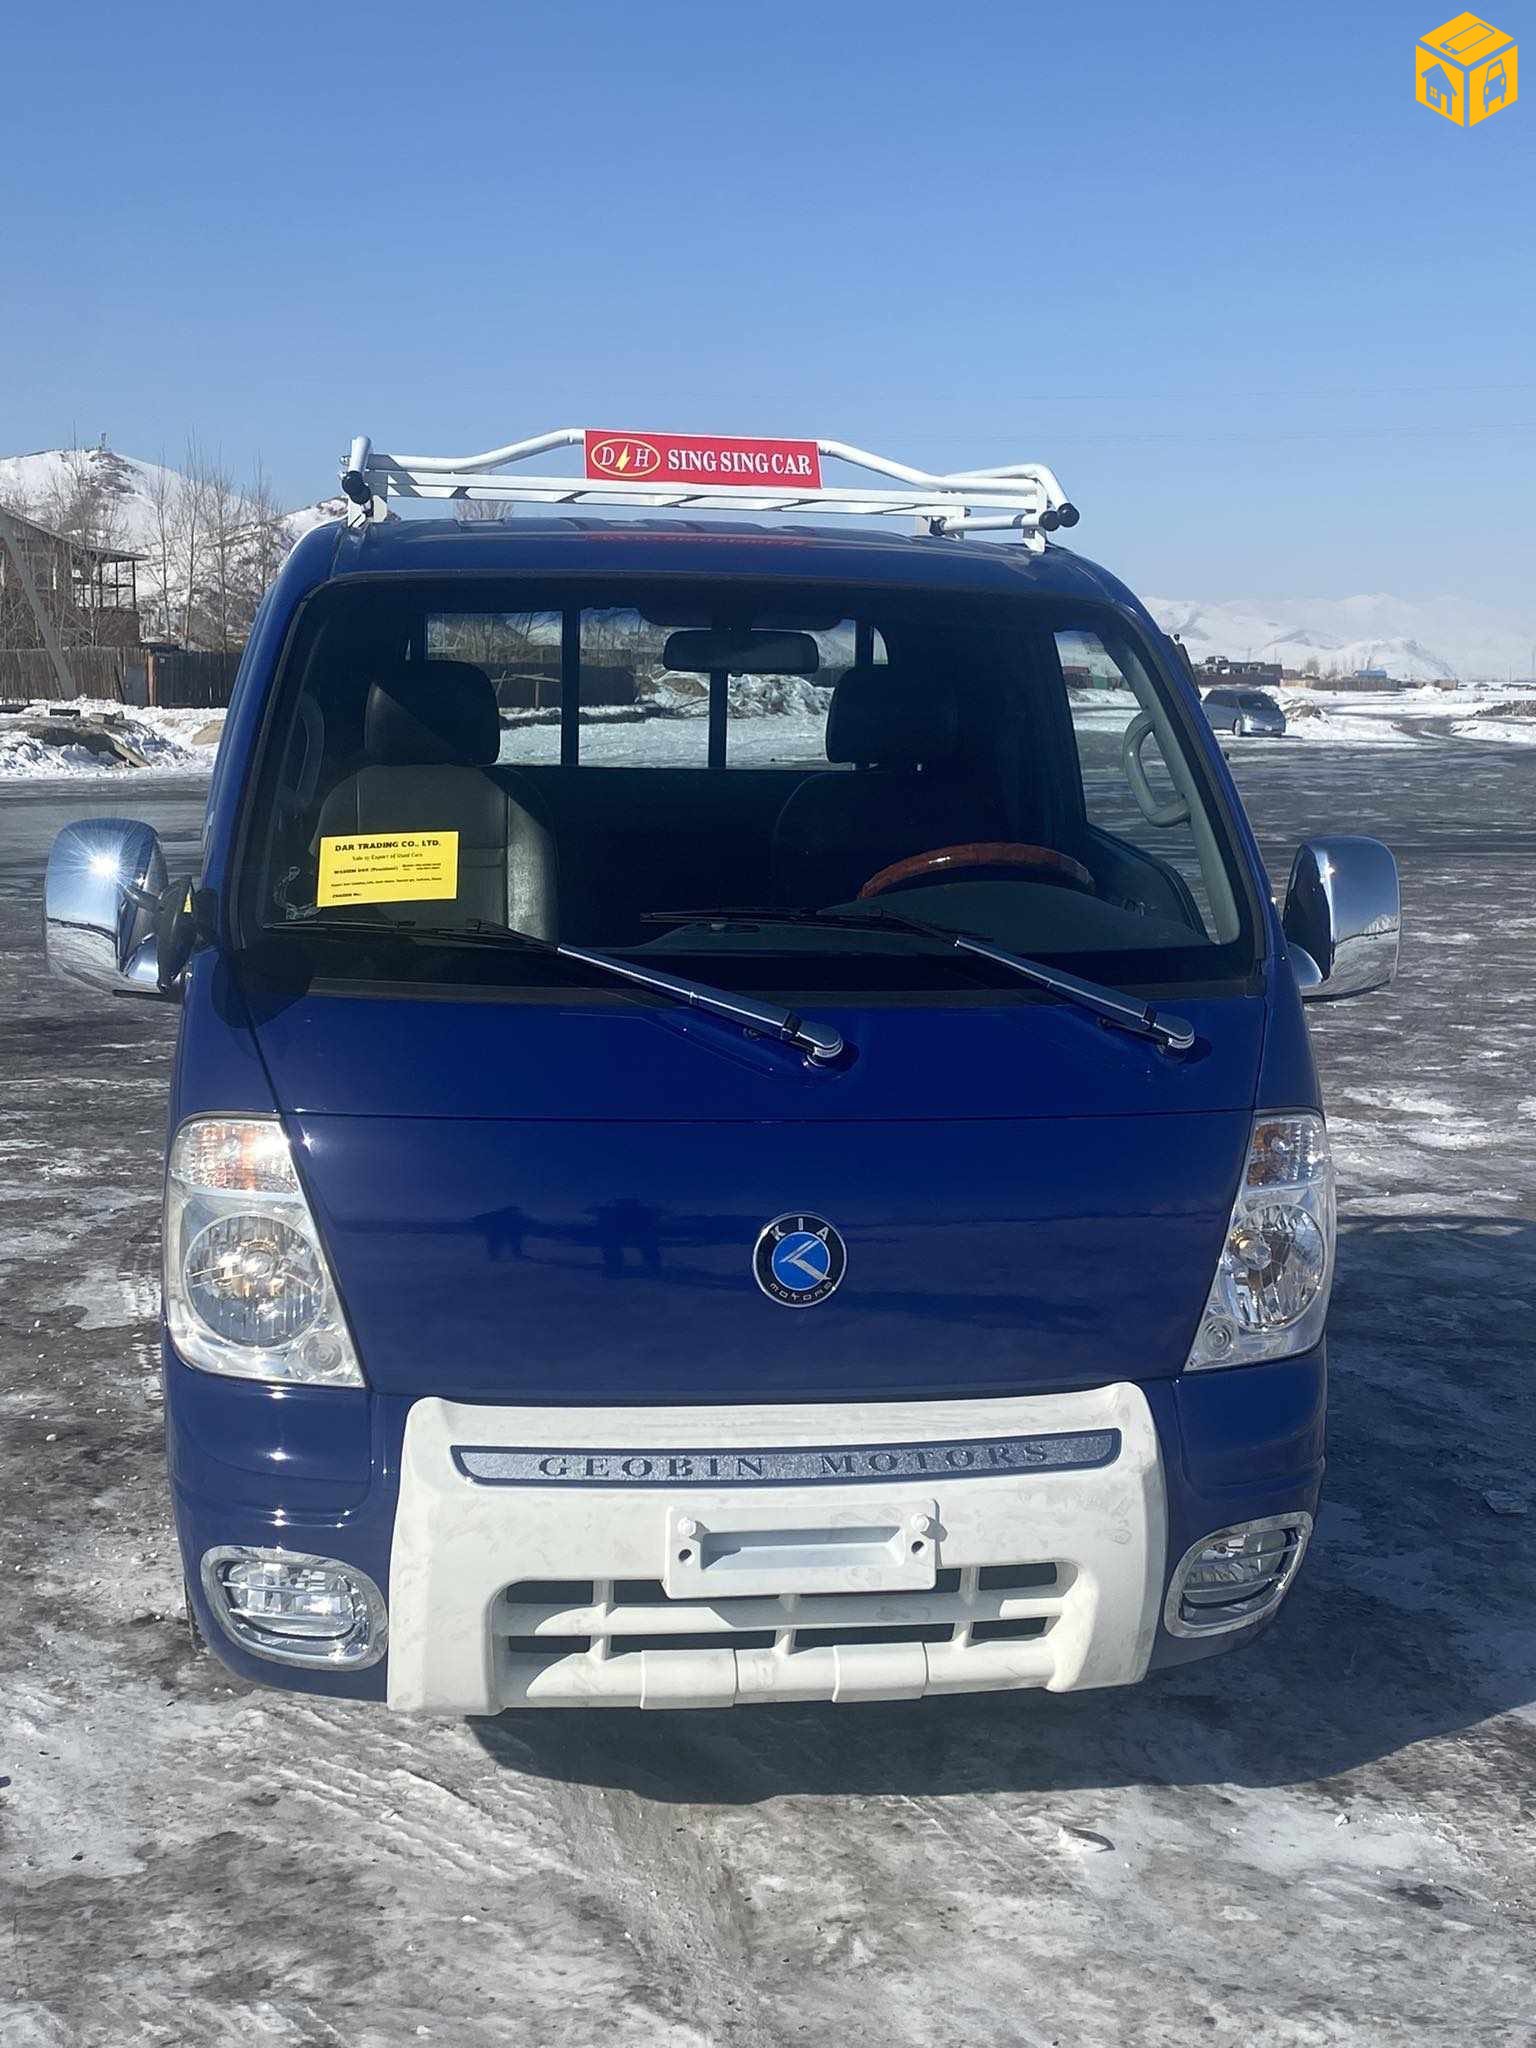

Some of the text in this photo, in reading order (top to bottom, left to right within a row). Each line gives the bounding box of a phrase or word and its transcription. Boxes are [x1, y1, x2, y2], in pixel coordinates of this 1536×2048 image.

[668, 449, 813, 476] SING SING CAR
[335, 844, 355, 852] DAR
[358, 841, 399, 850] TRADING
[770, 1217, 829, 1241] KIA
[538, 1444, 1048, 1477] GEOBIN MOTORS
